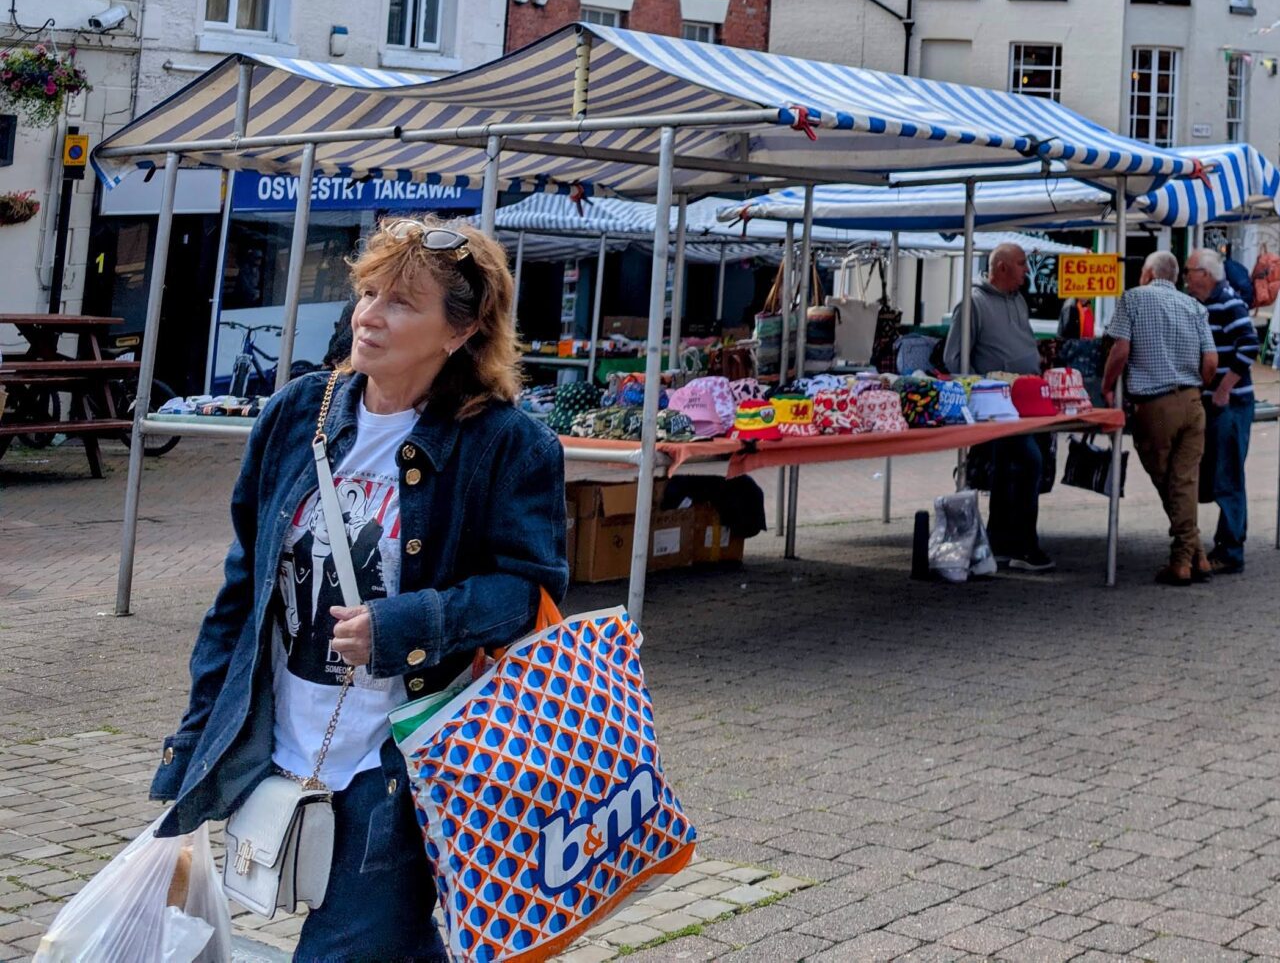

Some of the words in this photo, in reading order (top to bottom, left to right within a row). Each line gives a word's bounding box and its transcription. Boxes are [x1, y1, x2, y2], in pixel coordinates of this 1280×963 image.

[95, 252, 105, 273] 1
[1064, 259, 1087, 275] £6
[1089, 264, 1116, 275] EACH
[1087, 277, 1116, 291] £10
[325, 665, 348, 674] SOMEO
